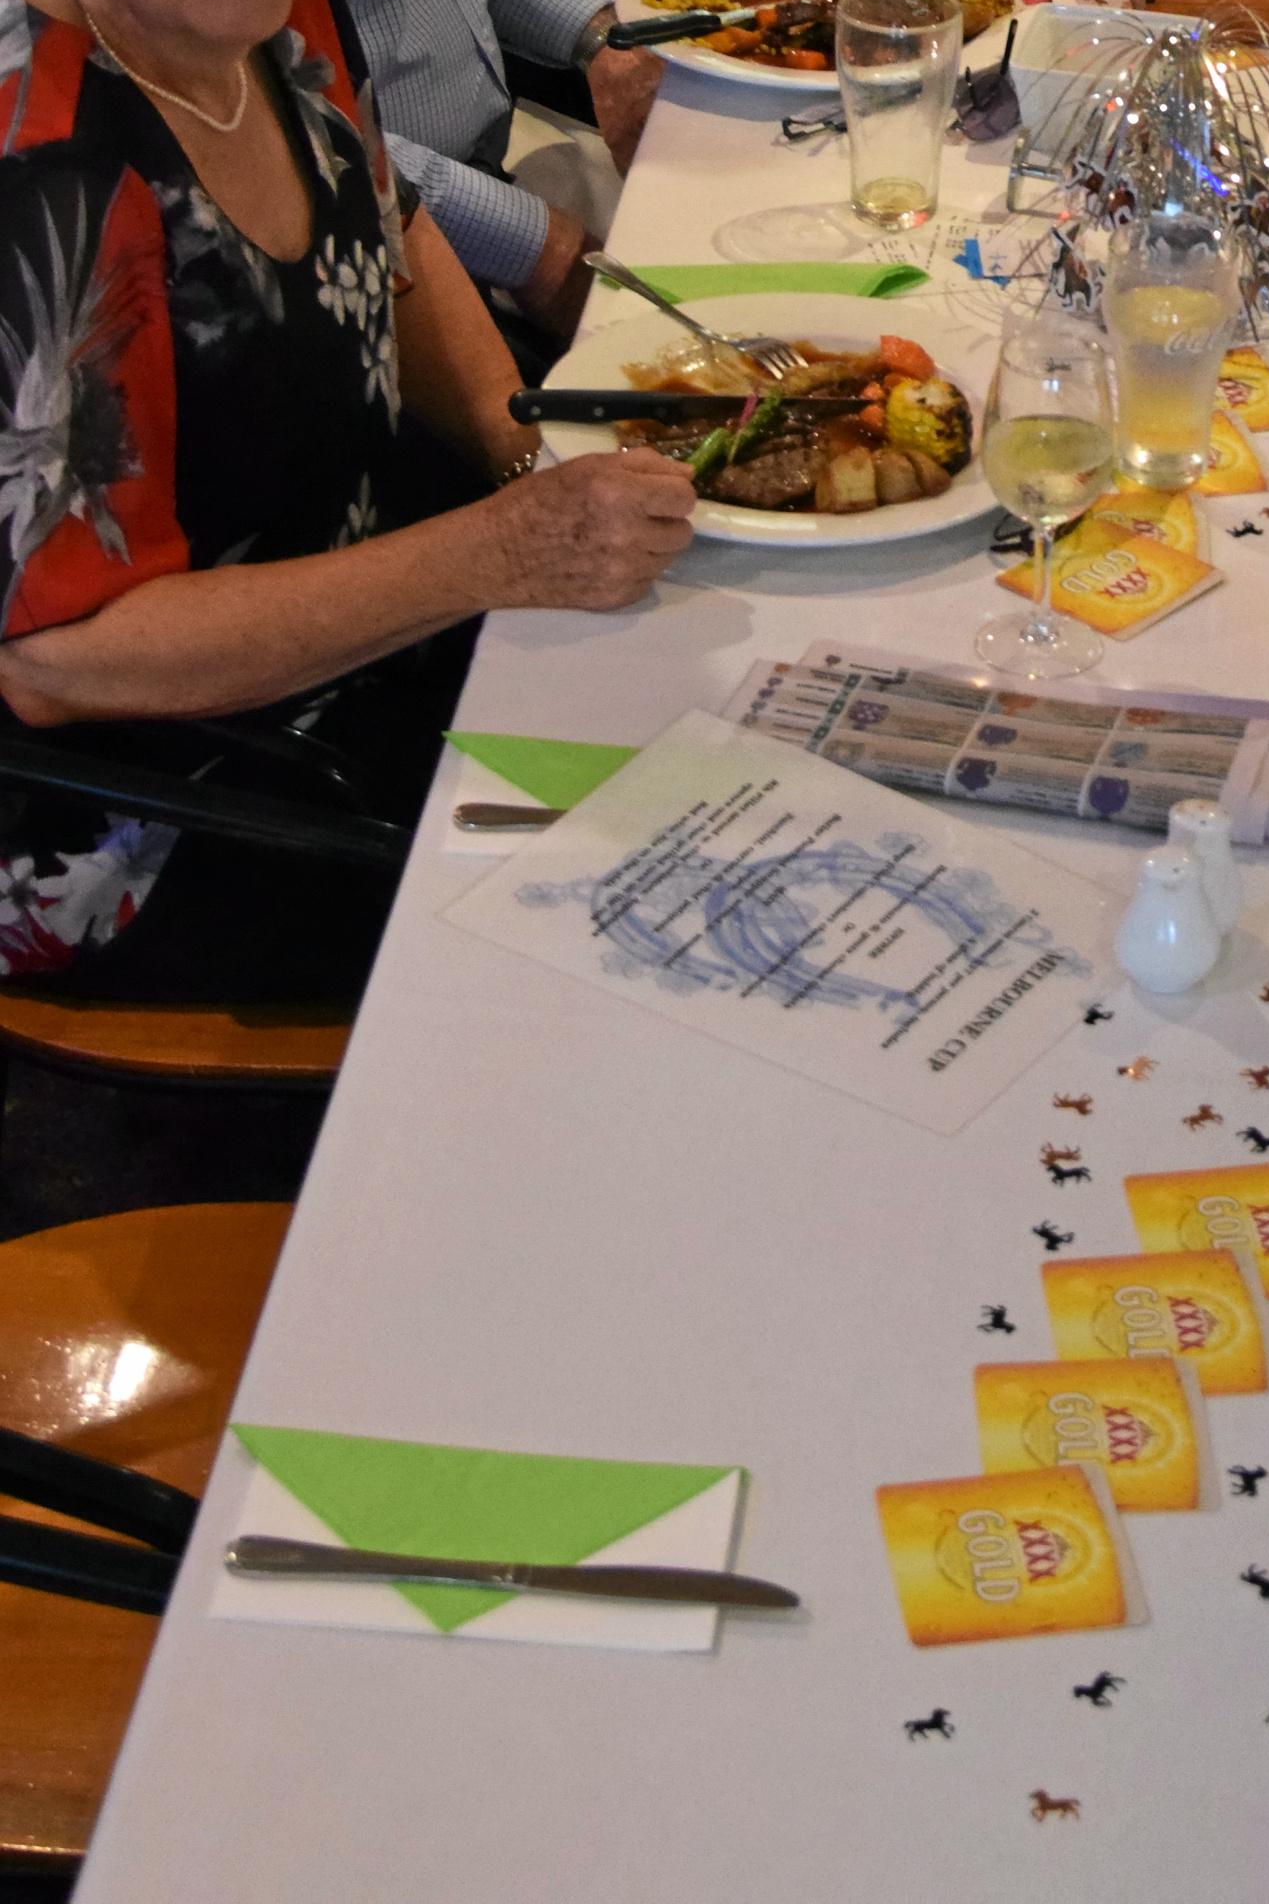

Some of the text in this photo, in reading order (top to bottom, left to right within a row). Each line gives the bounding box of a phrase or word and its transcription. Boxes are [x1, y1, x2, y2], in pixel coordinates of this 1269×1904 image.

[1060, 549, 1137, 594] GOLD
[1101, 566, 1148, 598] XXXX
[922, 951, 1066, 1073] MELBOURNE CUP
[1197, 1194, 1249, 1249] GOL
[1113, 1284, 1172, 1360] GOL
[1166, 1295, 1208, 1353] XXXX
[1047, 1391, 1100, 1466] GOL
[1101, 1405, 1137, 1465] XXXX
[956, 1508, 1020, 1604] GOLD
[1014, 1519, 1058, 1583] XXXX
